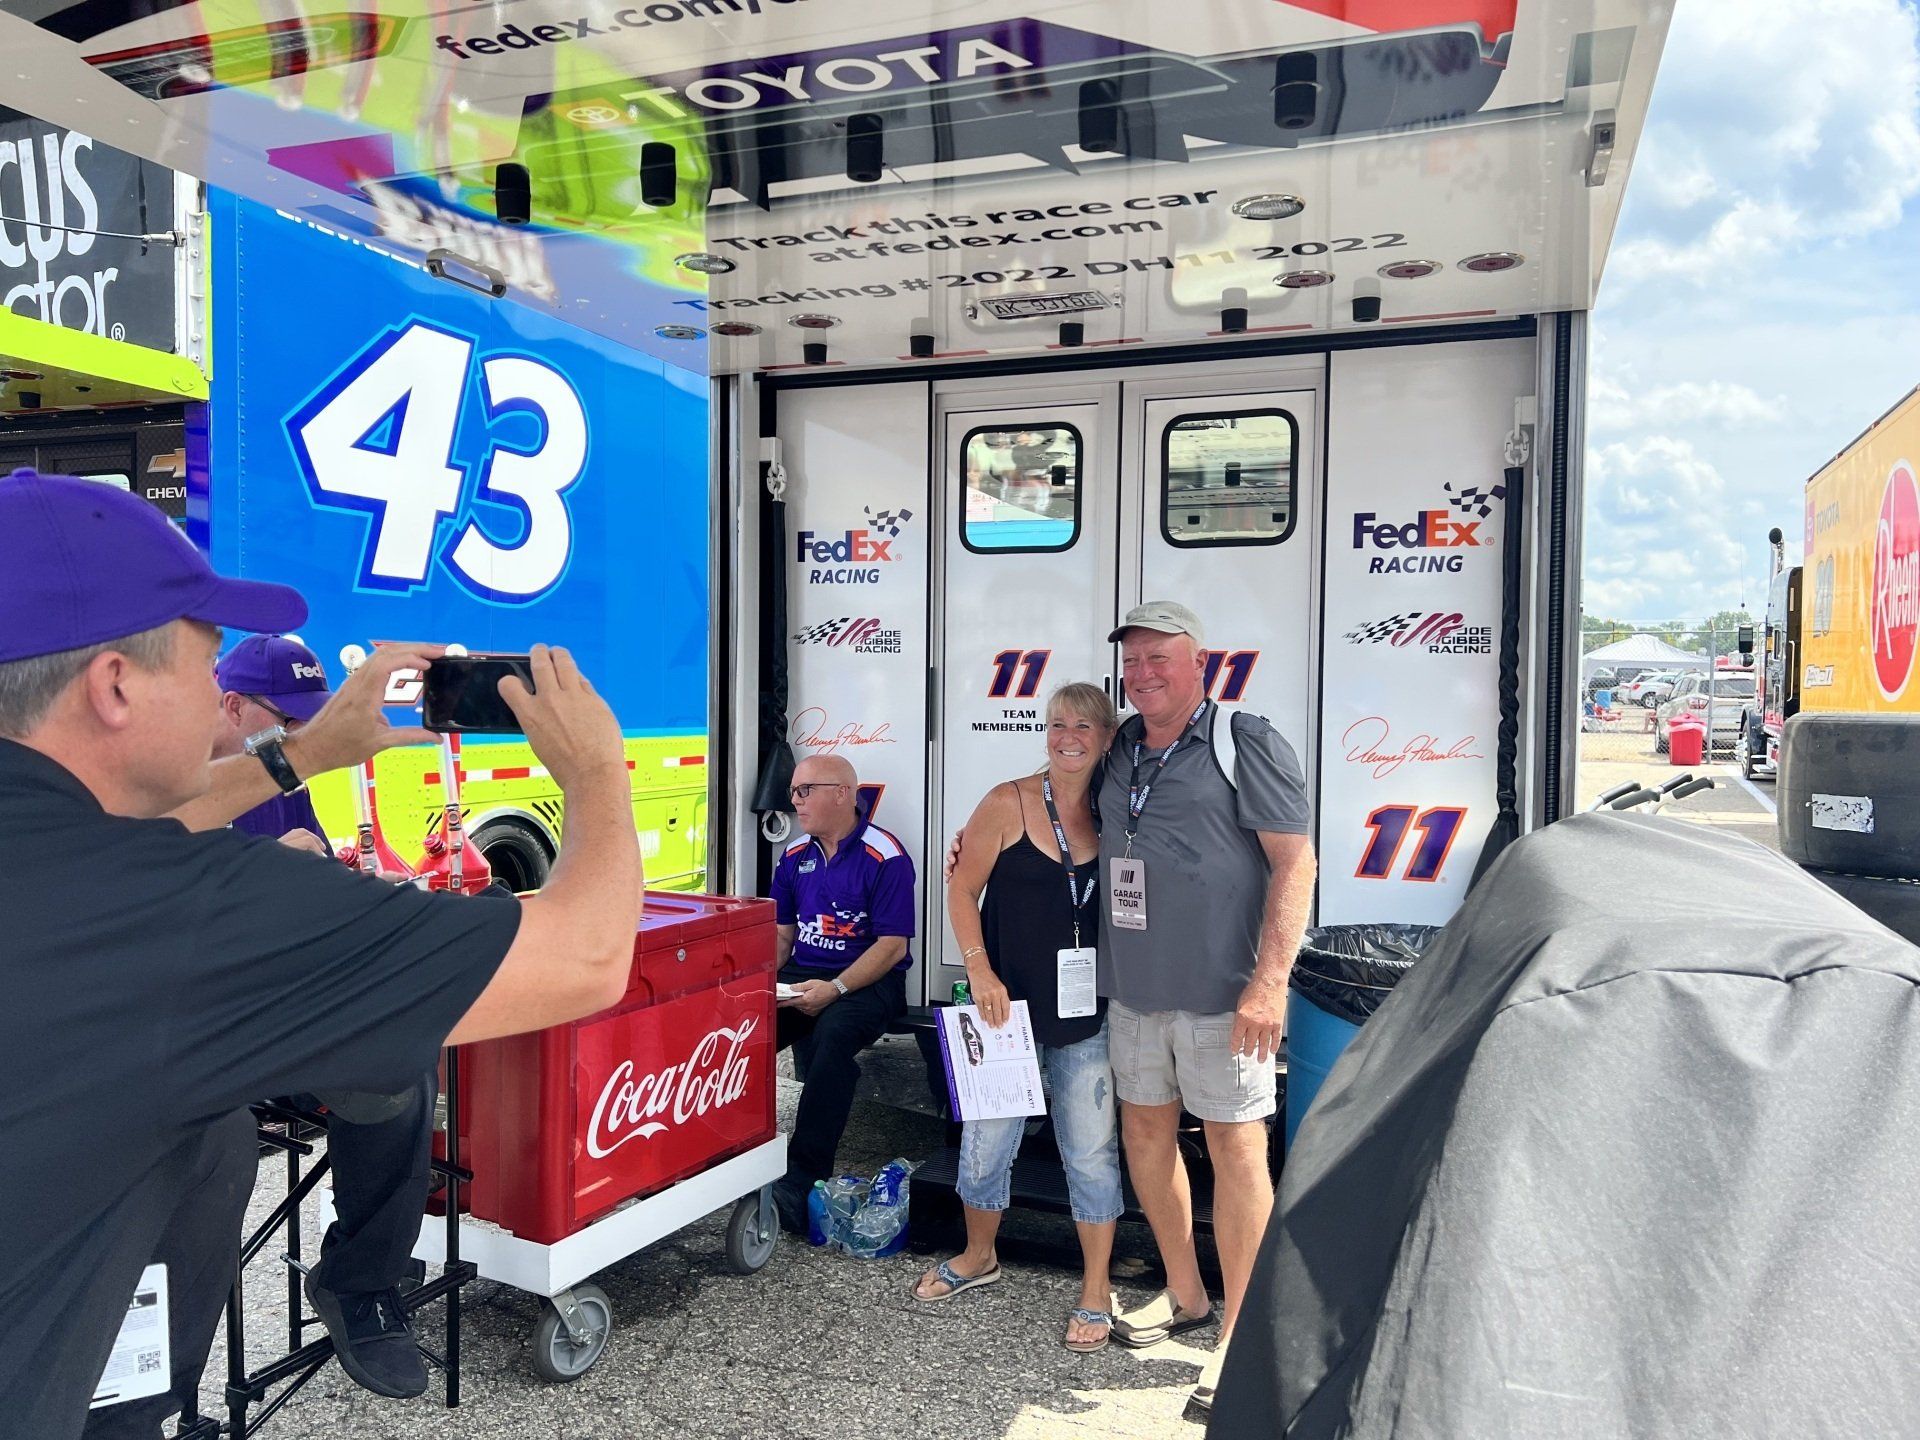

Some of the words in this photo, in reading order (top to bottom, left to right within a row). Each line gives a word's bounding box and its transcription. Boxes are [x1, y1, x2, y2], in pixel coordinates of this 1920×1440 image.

[620, 38, 1034, 119] TOYOTA
[711, 224, 867, 252] Track
[868, 212, 979, 234] this
[990, 202, 1113, 224] race
[1123, 190, 1218, 210] car
[808, 247, 867, 264] at
[864, 220, 1164, 257] fedex.com
[671, 282, 897, 312] Tracking
[936, 266, 1077, 289] 2022
[1083, 249, 1238, 277] DH11
[1252, 233, 1408, 260] 2022
[288, 317, 590, 604] 43
[146, 486, 187, 500] CHEV
[1353, 510, 1482, 549] FedEx
[1816, 501, 1840, 536] TOYOTA
[797, 529, 893, 563] FedEx
[809, 568, 880, 584] RACING
[1368, 555, 1464, 574] RACING
[875, 630, 901, 638] JOE
[1441, 636, 1491, 645] GIBBS
[1457, 627, 1492, 635] JOE
[855, 646, 901, 654] RACING
[1429, 645, 1491, 654] RACING
[291, 662, 325, 679] Fed
[987, 649, 1051, 698] 11
[1002, 710, 1036, 719] TEAM
[972, 722, 1032, 732] MEMBERS
[1162, 740, 1180, 761] NASCAR
[1135, 785, 1151, 811] NASCAR
[1055, 828, 1068, 853] NASCAR
[1354, 804, 1469, 882] 11
[1069, 880, 1078, 906] NASCAR
[1113, 889, 1143, 900] GARAGE
[1119, 899, 1139, 909] TOUR
[798, 929, 846, 951] RACING
[1021, 1026, 1031, 1051] HAMLIN
[587, 1014, 760, 1159] Coca-Cola
